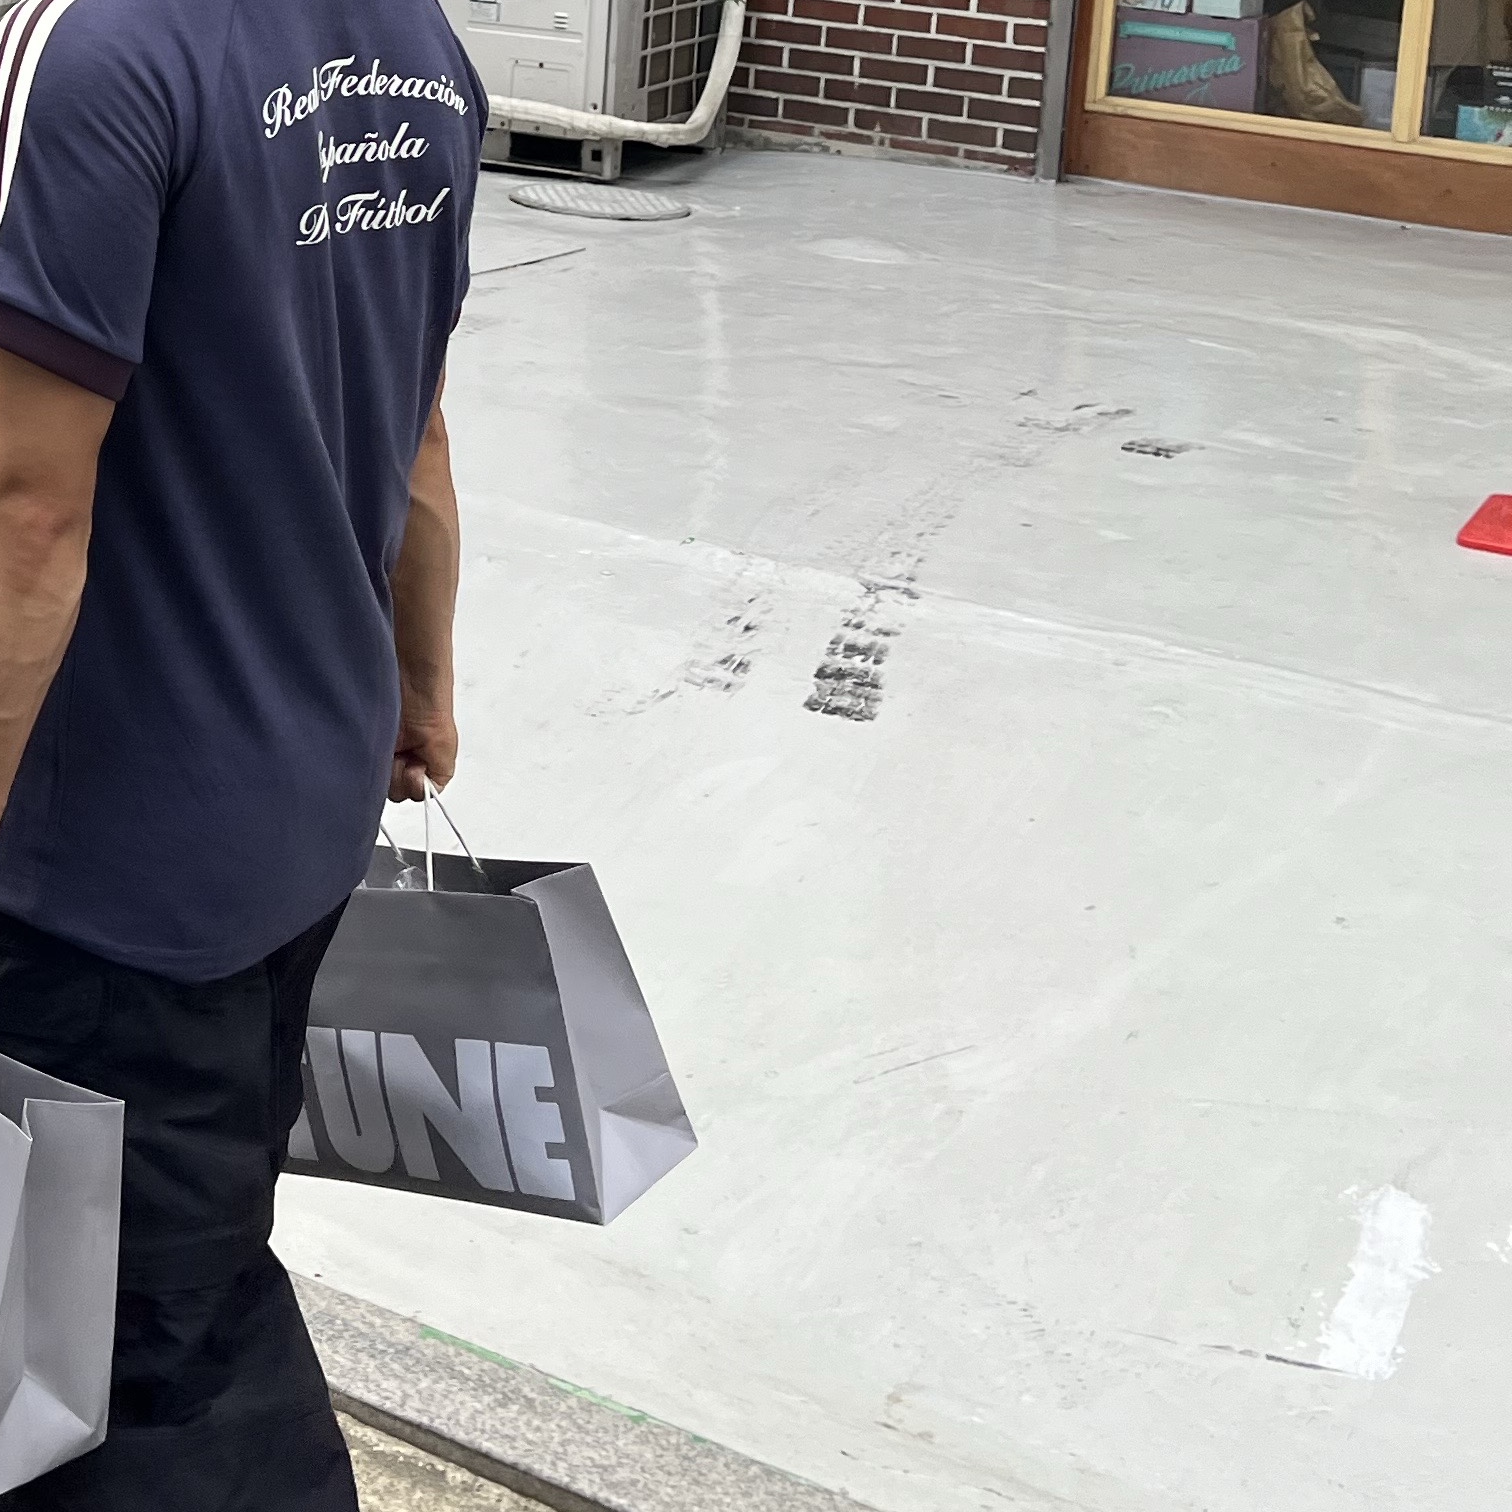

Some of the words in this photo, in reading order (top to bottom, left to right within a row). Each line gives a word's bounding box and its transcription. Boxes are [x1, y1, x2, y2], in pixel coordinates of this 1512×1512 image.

[318, 54, 469, 116] Federación
[317, 122, 430, 184] spañola
[335, 187, 451, 235] Fútbol
